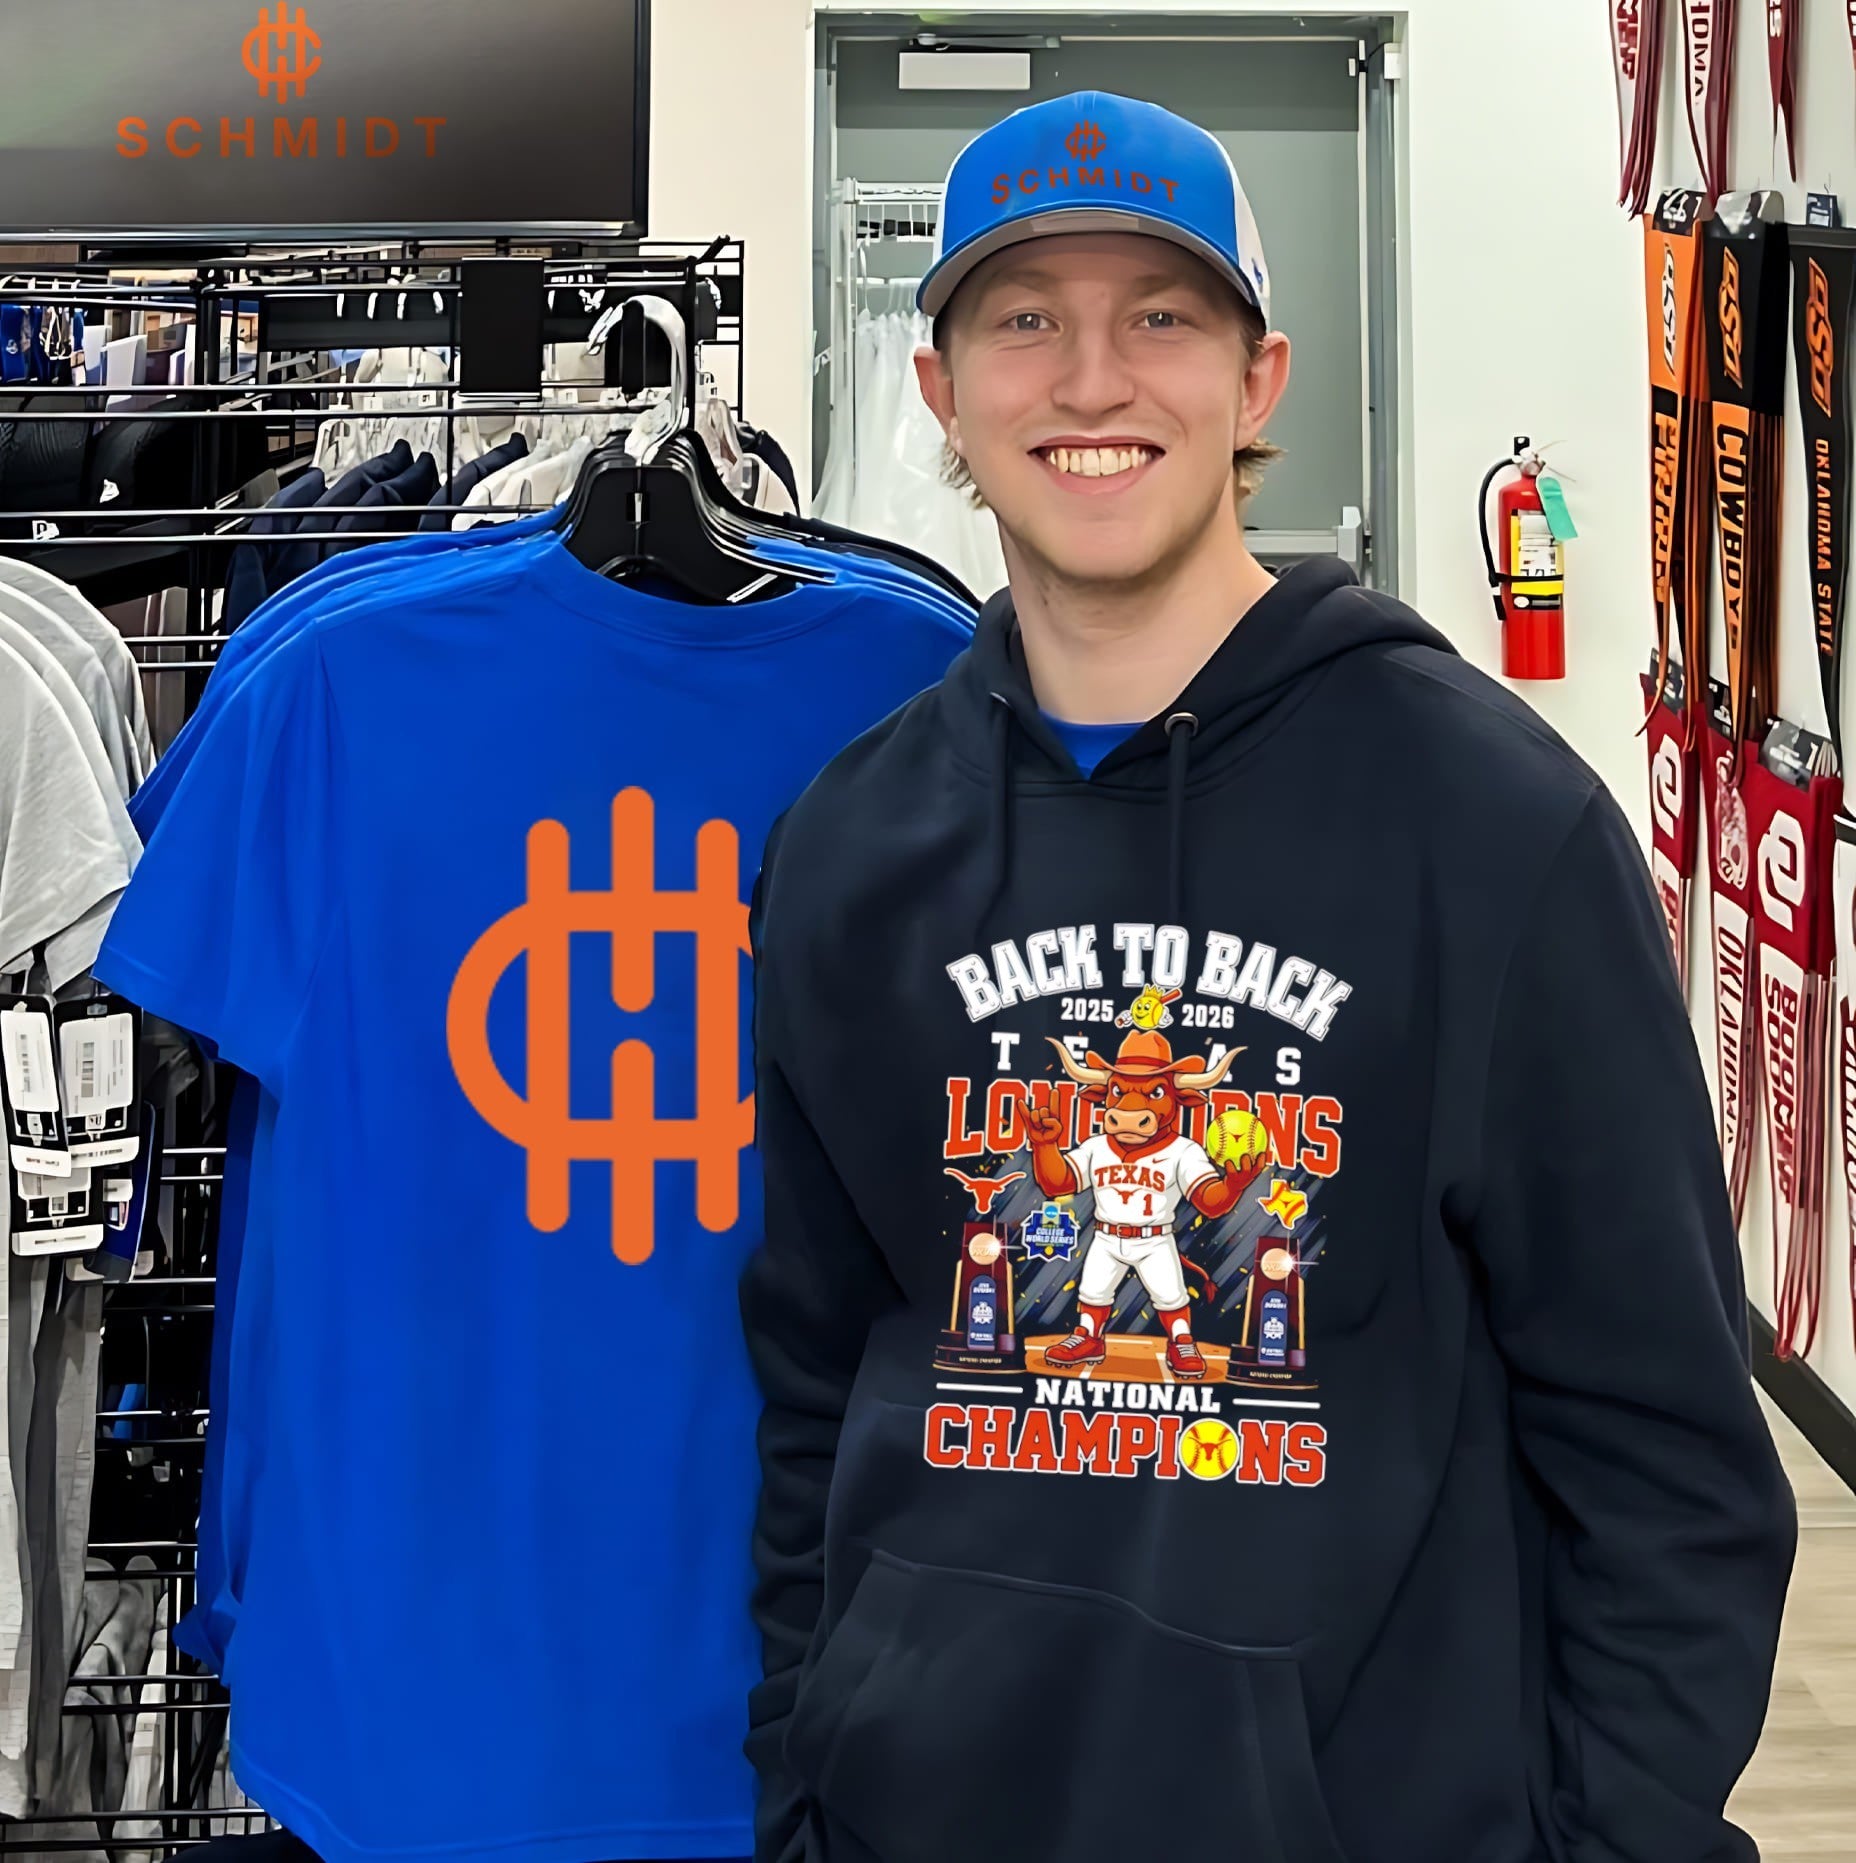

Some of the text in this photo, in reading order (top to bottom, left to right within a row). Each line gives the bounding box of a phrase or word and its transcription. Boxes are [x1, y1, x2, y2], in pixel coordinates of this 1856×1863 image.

[116, 117, 448, 159] SCHMIDT
[991, 167, 1180, 205] SCHMIDT
[945, 922, 1354, 1042] BACK TO BACK
[1060, 997, 1114, 1023] 2025
[1181, 1004, 1235, 1029] 2026
[1718, 925, 1745, 1144] OKLAHOMA
[991, 1031, 1302, 1085] TEAS
[943, 1077, 1342, 1178] LONGONS
[1093, 1165, 1166, 1193] TEXAS
[1142, 1193, 1153, 1217] 1
[1034, 1378, 1222, 1414] NATIONAL
